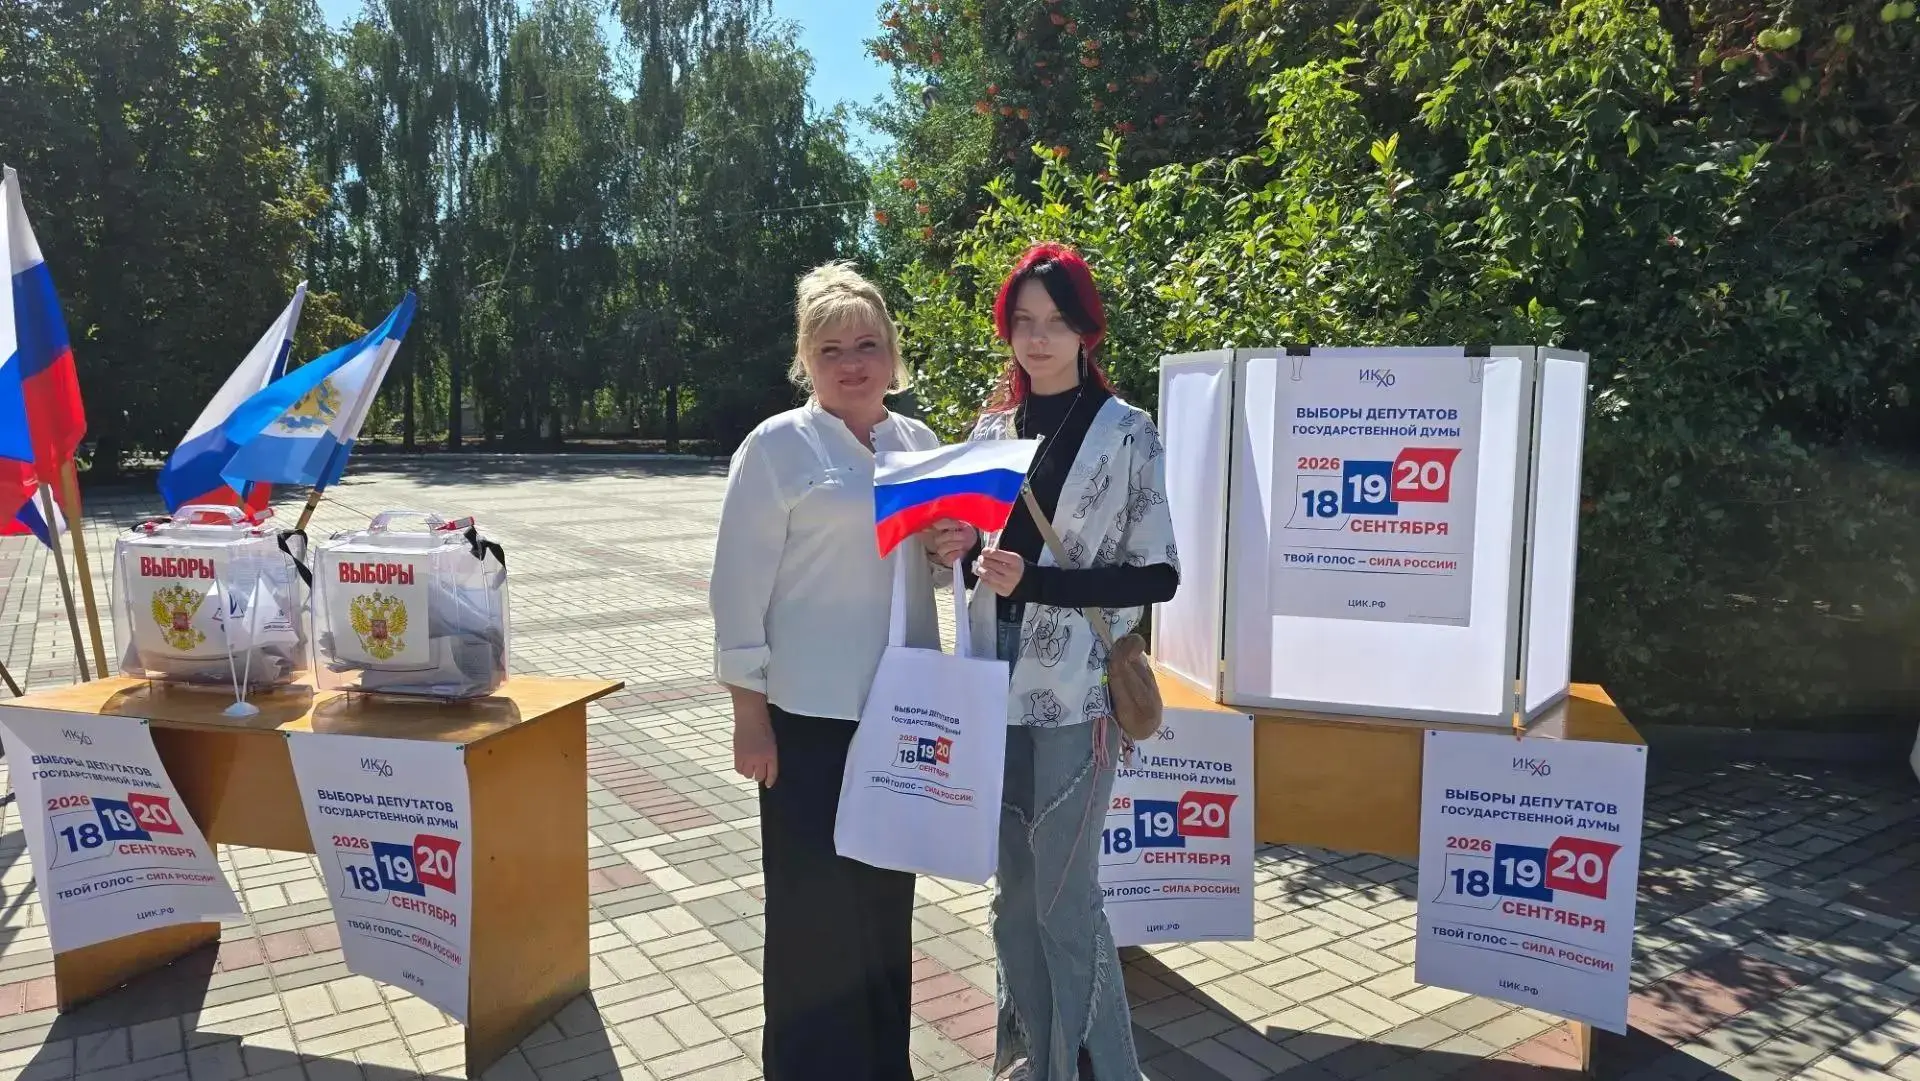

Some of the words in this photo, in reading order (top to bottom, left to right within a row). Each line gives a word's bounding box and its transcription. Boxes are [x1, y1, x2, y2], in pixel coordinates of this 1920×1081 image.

[1296, 408, 1362, 419] ВЫБОРЫ
[1366, 408, 1458, 420] ДЕПУТАТОВ
[1292, 424, 1416, 436] ГОСУДАРСТВЕННОЙ
[1420, 427, 1460, 437] ДУМЫ
[1298, 457, 1340, 470] 2026
[1302, 490, 1338, 518] 18
[1348, 474, 1387, 504] 19
[1397, 461, 1446, 490] 20
[1350, 520, 1448, 535] СЕНТЯБРЯ
[140, 556, 214, 579] ВЫБОРЫ
[1284, 553, 1314, 563] ТВОЙ
[1317, 555, 1355, 565] ГОЛОС
[1369, 557, 1401, 568] СИЛА
[1404, 559, 1457, 570] РОССИИ!
[339, 562, 414, 584] ВЫБОРЫ
[1348, 600, 1386, 609] ЦИК.РФ
[895, 706, 928, 714] ВЫБОРЫ
[900, 750, 915, 763] 18
[920, 745, 934, 758] 19
[936, 743, 948, 756] 20
[32, 755, 84, 767] ВЫБОРЫ
[86, 760, 152, 776] ДЕПУТАТОВ
[1152, 756, 1232, 772] ДЕПУТАТОВ
[32, 772, 130, 785] ГОСУДАРСТВЕННОЙ
[133, 779, 161, 789] ДУМЫ
[872, 776, 890, 784] ТВОЙ
[891, 780, 916, 789] ГОЛОС
[1200, 775, 1236, 785] ДУМЫ
[48, 796, 90, 811] 2026
[318, 790, 374, 804] ВЫБОРЫ
[377, 796, 453, 812] ДЕПУТАТОВ
[1112, 798, 1130, 808] 26
[1445, 789, 1515, 805] ВЫБОРЫ
[1519, 795, 1617, 814] ДЕПУТАТОВ
[319, 805, 424, 824] ГОСУДАРСТВЕННОЙ
[426, 816, 458, 829] ДУМЫ
[1441, 805, 1574, 826] ГОСУДАРСТВЕННОЙ
[1577, 818, 1620, 832] ДУМЫ
[60, 823, 103, 852] 18
[102, 808, 136, 832] 19
[133, 802, 172, 826] 20
[1102, 828, 1132, 854] 18
[1139, 812, 1174, 838] 19
[1182, 802, 1225, 828] 20
[118, 844, 196, 858] СЕНТЯБРЯ
[332, 836, 370, 850] 2026
[1446, 837, 1491, 851] 2026
[1144, 852, 1231, 865] СЕНТЯБРЯ
[345, 865, 380, 892] 18
[380, 854, 414, 883] 19
[417, 846, 451, 880] 20
[1451, 869, 1490, 897] 18
[1500, 858, 1541, 888] 19
[1552, 850, 1603, 884] 20
[57, 884, 92, 900] ТВОЙ
[94, 876, 134, 891] ГОЛОС
[1117, 886, 1150, 896] ГОЛОС
[1162, 885, 1191, 893] СИЛА
[1194, 886, 1240, 894] РОССИИ!
[392, 896, 456, 926] СЕНТЯБРЯ
[1503, 901, 1605, 933] СЕНТЯБРЯ
[347, 920, 372, 932] ТВОЙ
[373, 926, 402, 938] ГОЛОС
[412, 934, 432, 948] СИЛА
[1432, 926, 1464, 938] ТВОЙ
[1467, 932, 1507, 946] ГОЛОС
[1522, 941, 1555, 957] СИЛА
[1558, 951, 1614, 971] РОССИИ!
[1499, 980, 1539, 996] ЦИК.РФ
